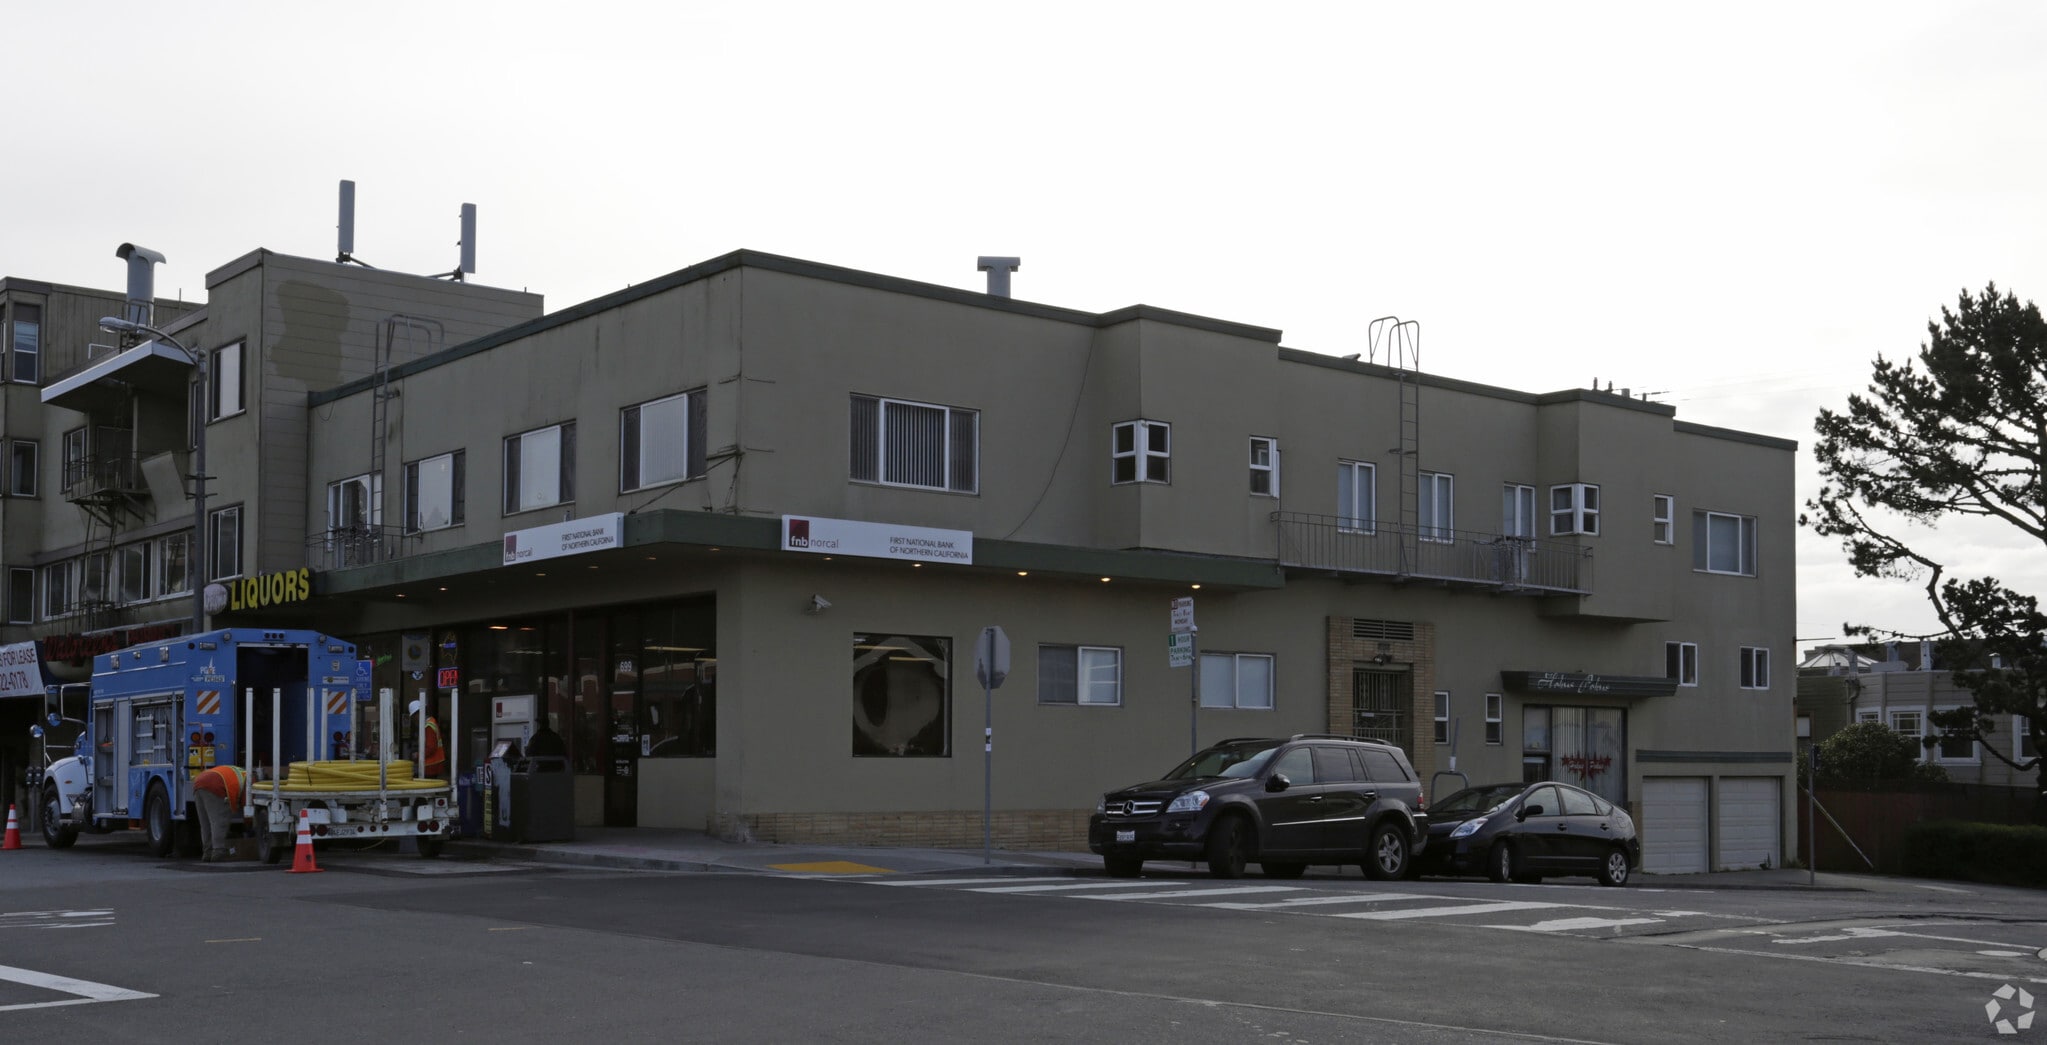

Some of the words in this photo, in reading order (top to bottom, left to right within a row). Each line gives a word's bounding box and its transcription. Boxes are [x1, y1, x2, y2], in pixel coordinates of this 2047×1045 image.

[562, 533, 573, 542] FIRST
[573, 530, 592, 540] NATIONAL
[592, 528, 605, 537] BANK
[561, 544, 569, 552] OF
[569, 541, 590, 550] NORTHERN
[590, 536, 615, 547] CALIFORNIA
[790, 536, 809, 547] fnb
[810, 538, 839, 549] norcal
[890, 536, 906, 545] FIRST
[906, 538, 937, 547] NATIONAL
[937, 541, 954, 549] BANK
[505, 551, 516, 561] fnb
[516, 547, 533, 558] norcal
[890, 546, 898, 554] OF
[899, 547, 933, 557] NORTHERN
[933, 549, 969, 560] CALIFORNIA
[231, 567, 310, 611] LIQUORS
[3, 651, 17, 667] FOR
[18, 648, 36, 664] LEASE
[1170, 646, 1192, 655] PARKING
